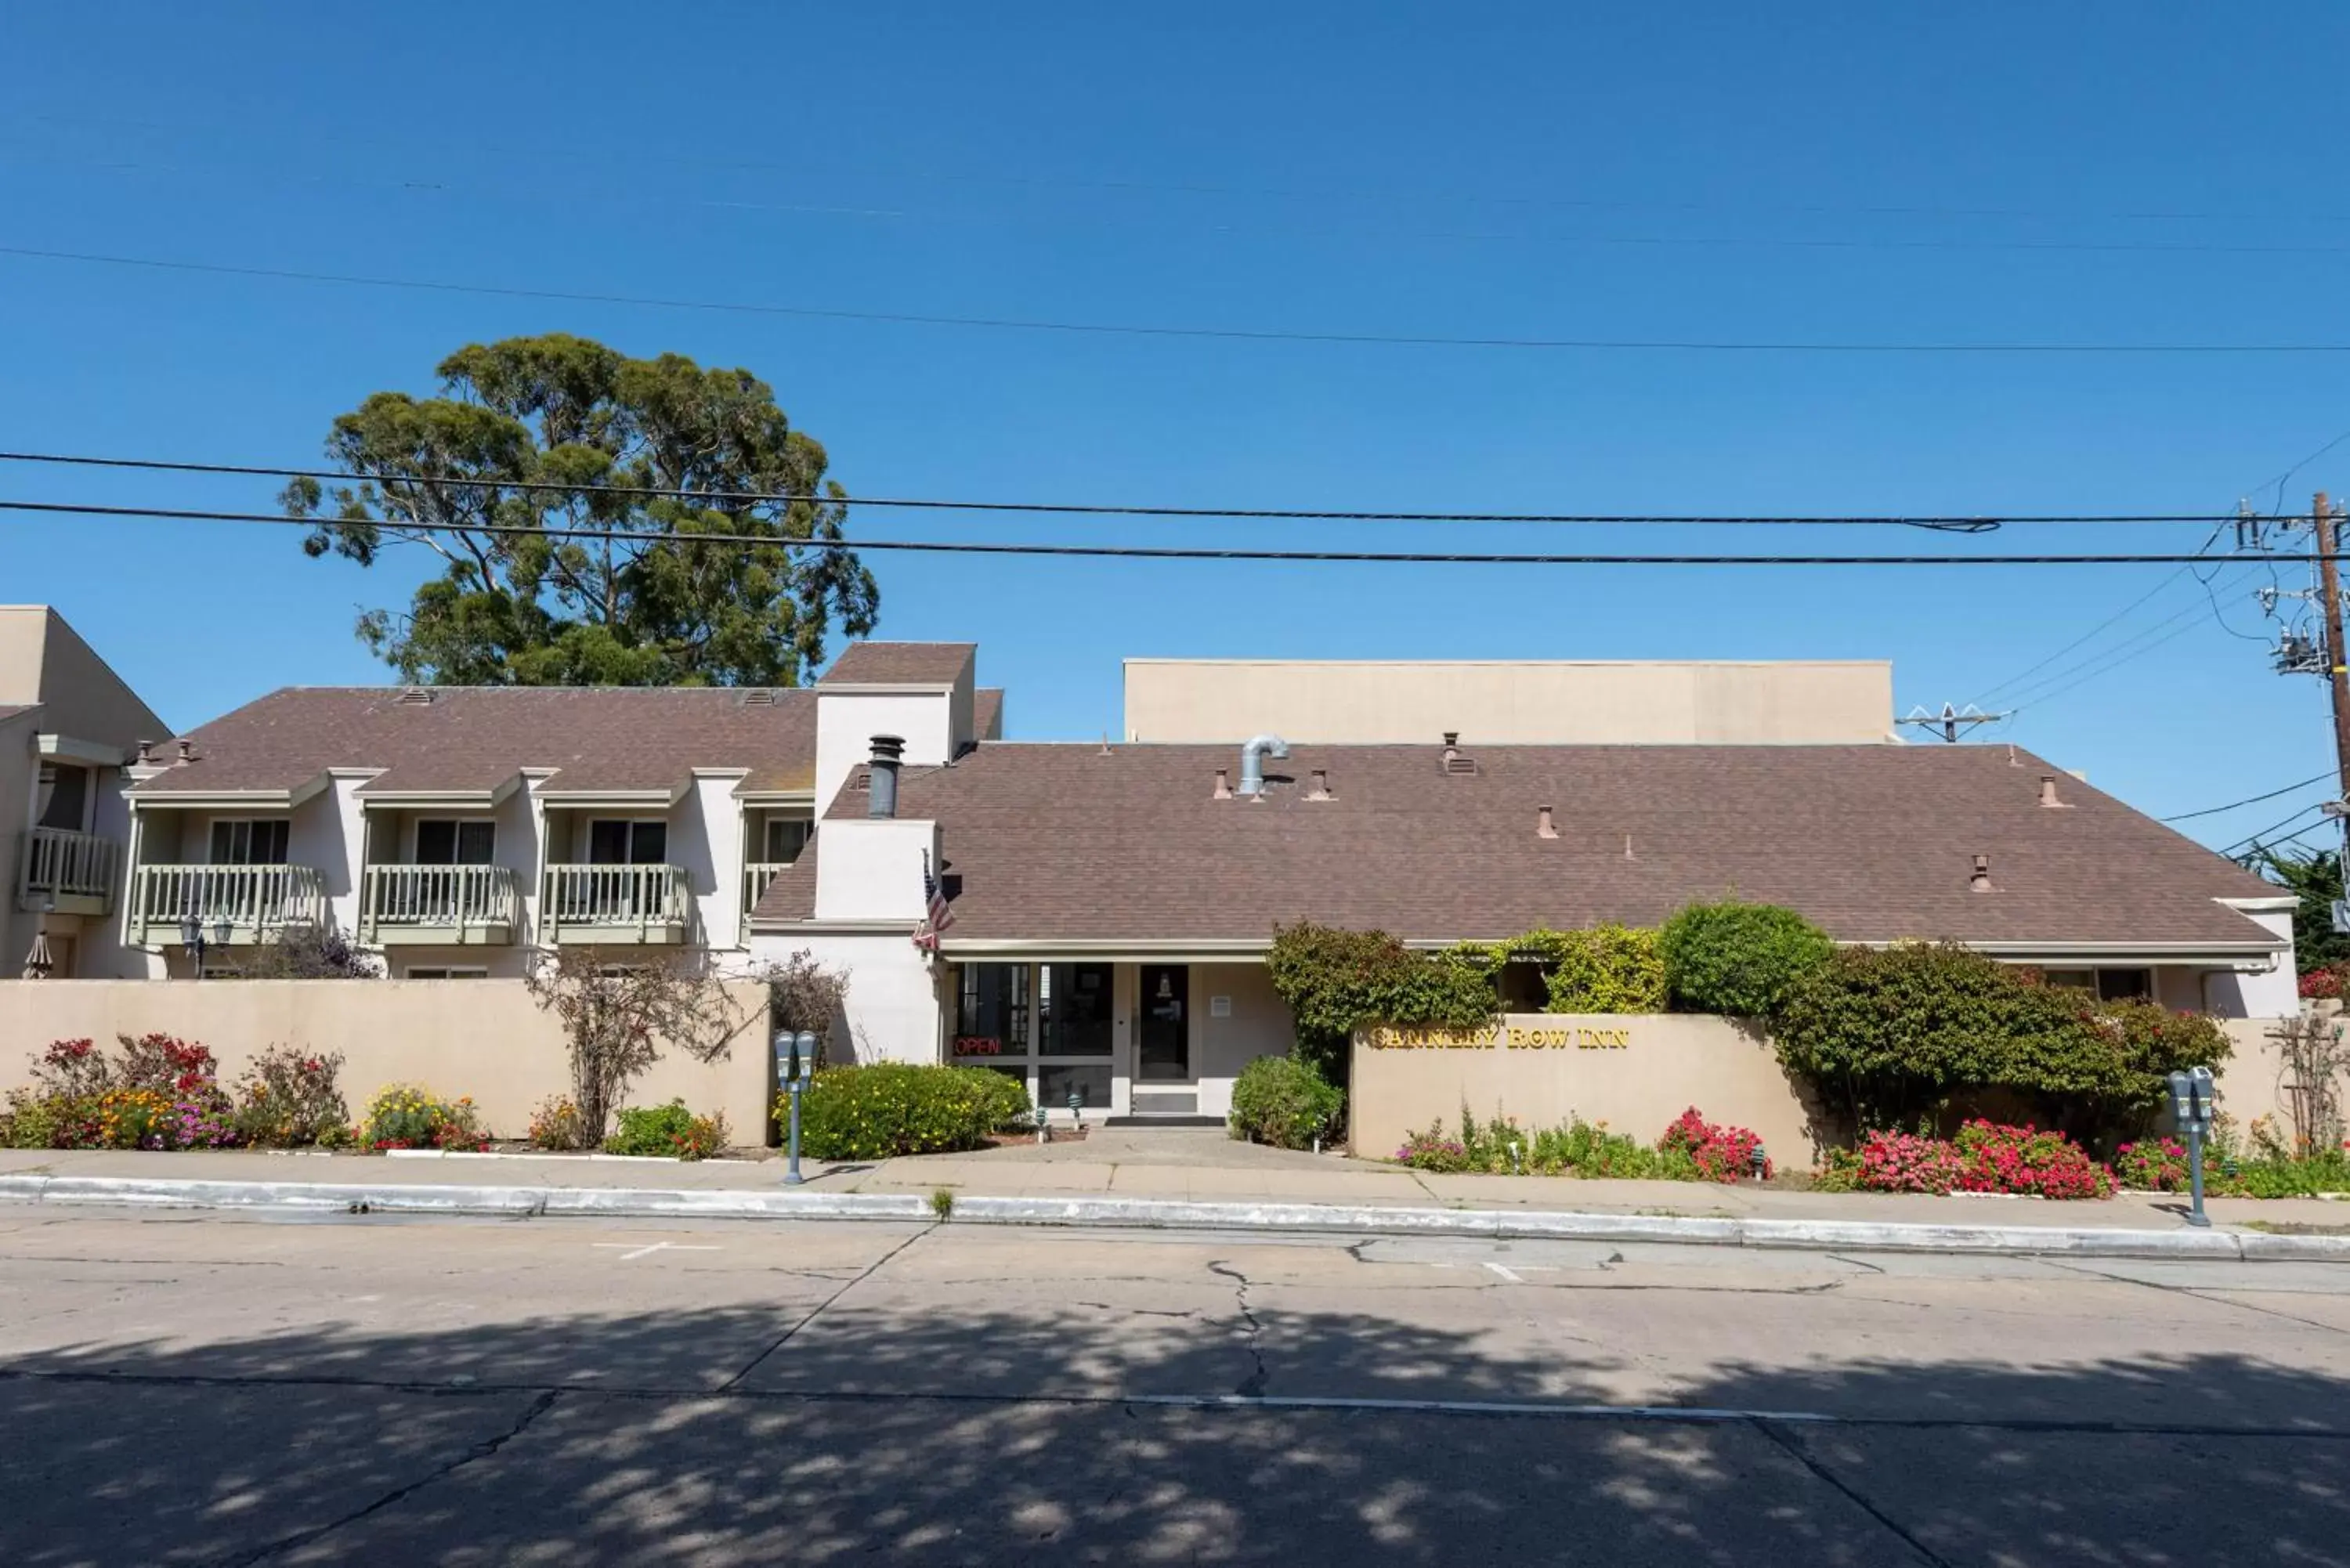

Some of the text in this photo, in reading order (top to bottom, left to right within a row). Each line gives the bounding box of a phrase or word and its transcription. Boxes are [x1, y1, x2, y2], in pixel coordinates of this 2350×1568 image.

[955, 1038, 1001, 1054] OPEN
[1507, 1027, 1570, 1048] ROW
[1578, 1027, 1629, 1048] INN
